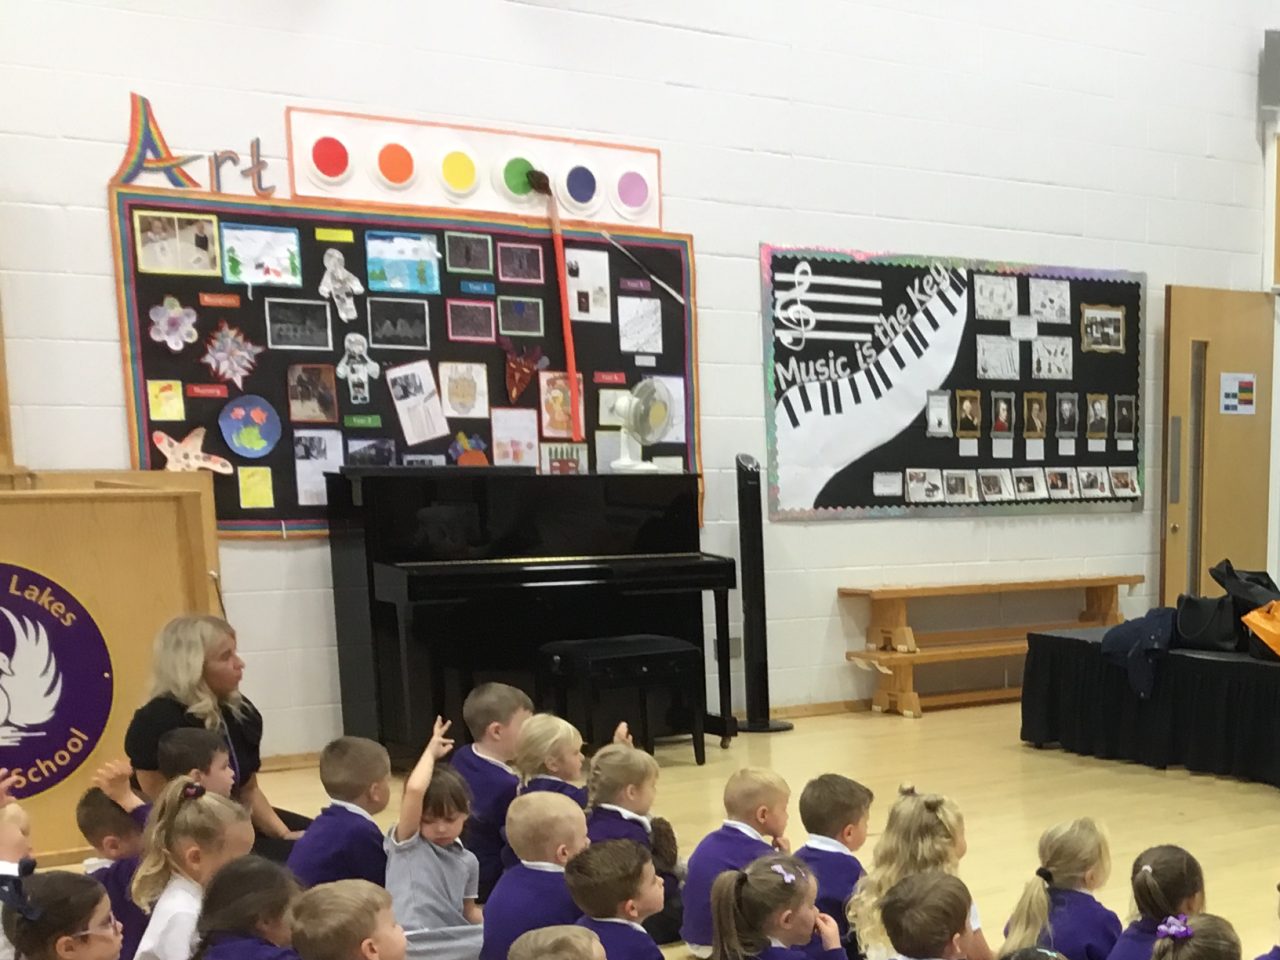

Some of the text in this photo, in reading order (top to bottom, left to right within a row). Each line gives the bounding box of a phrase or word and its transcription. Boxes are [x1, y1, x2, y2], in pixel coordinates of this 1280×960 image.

[108, 91, 276, 198] Art
[775, 261, 951, 391] Music is the Key
[9, 574, 77, 628] Lakes
[11, 727, 89, 789] School
